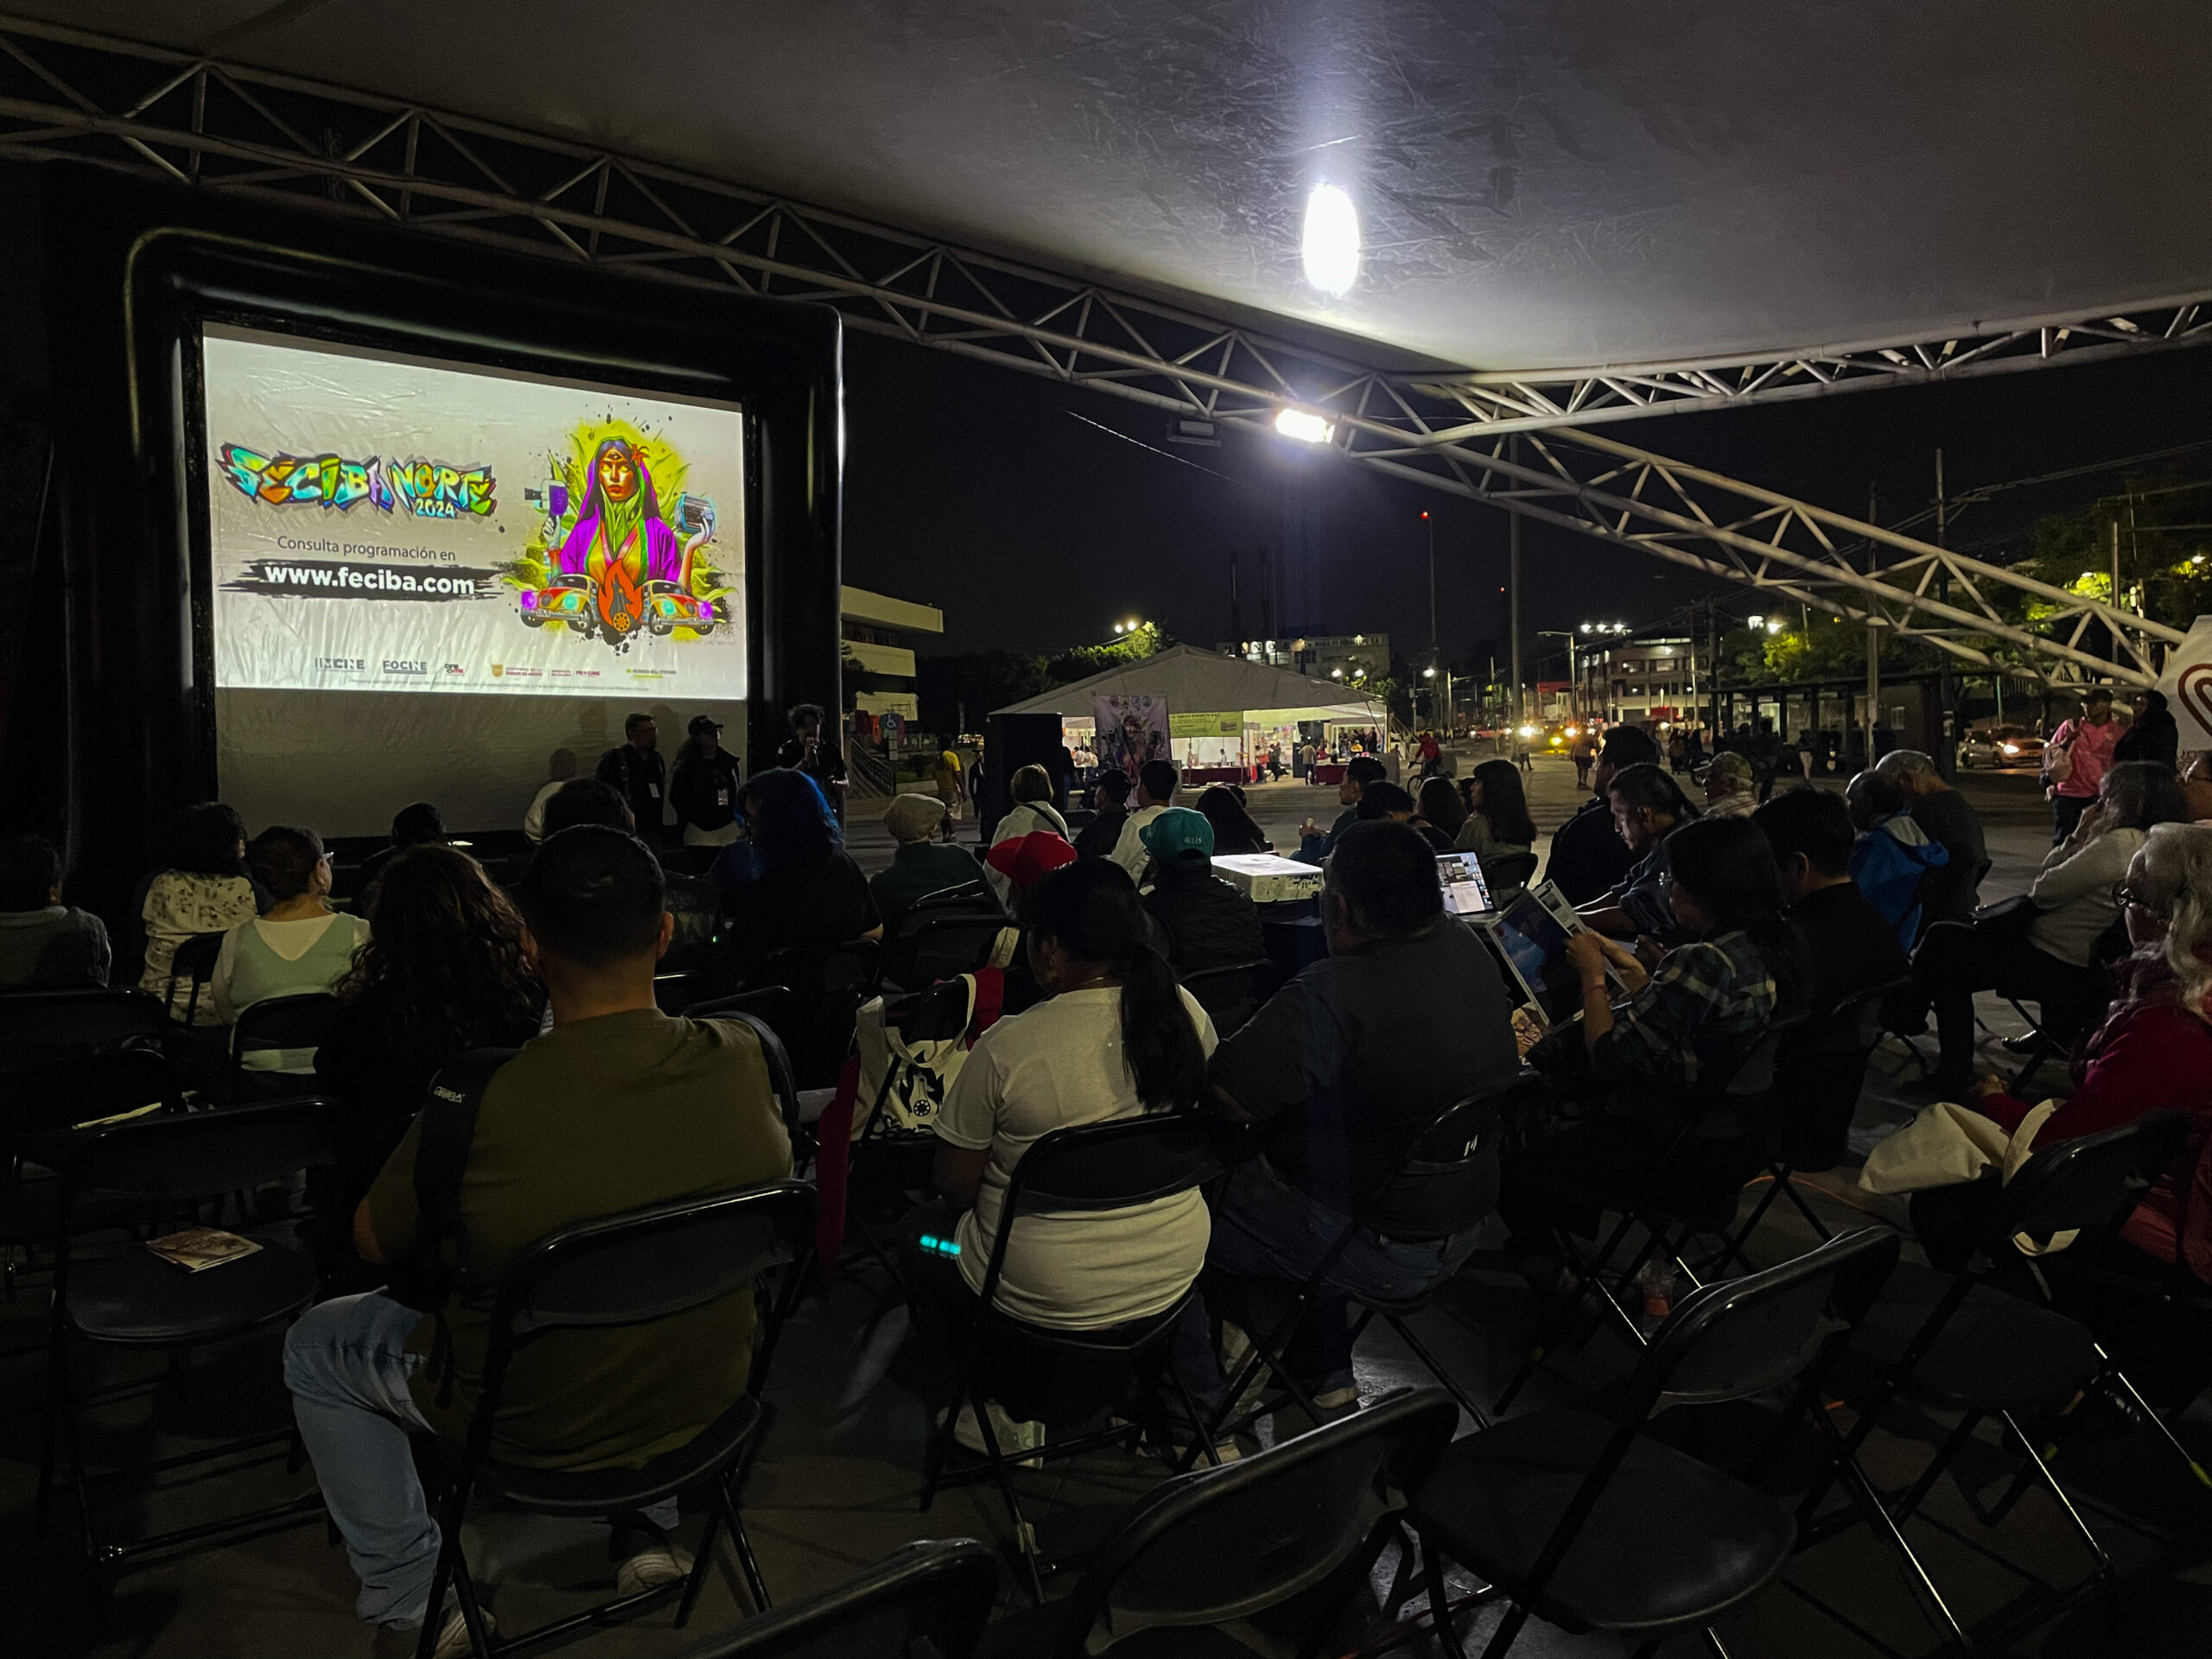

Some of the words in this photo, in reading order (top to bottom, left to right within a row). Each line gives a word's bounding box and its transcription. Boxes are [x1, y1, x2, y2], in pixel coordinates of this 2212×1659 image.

[215, 442, 393, 513] FECIBA
[386, 454, 498, 517] NORTE
[416, 499, 456, 518] 2024
[277, 535, 340, 553] Consulta
[343, 543, 436, 560] programación
[440, 550, 456, 561] en
[264, 566, 474, 594] www.feciba.com
[382, 659, 427, 671] FOCINE
